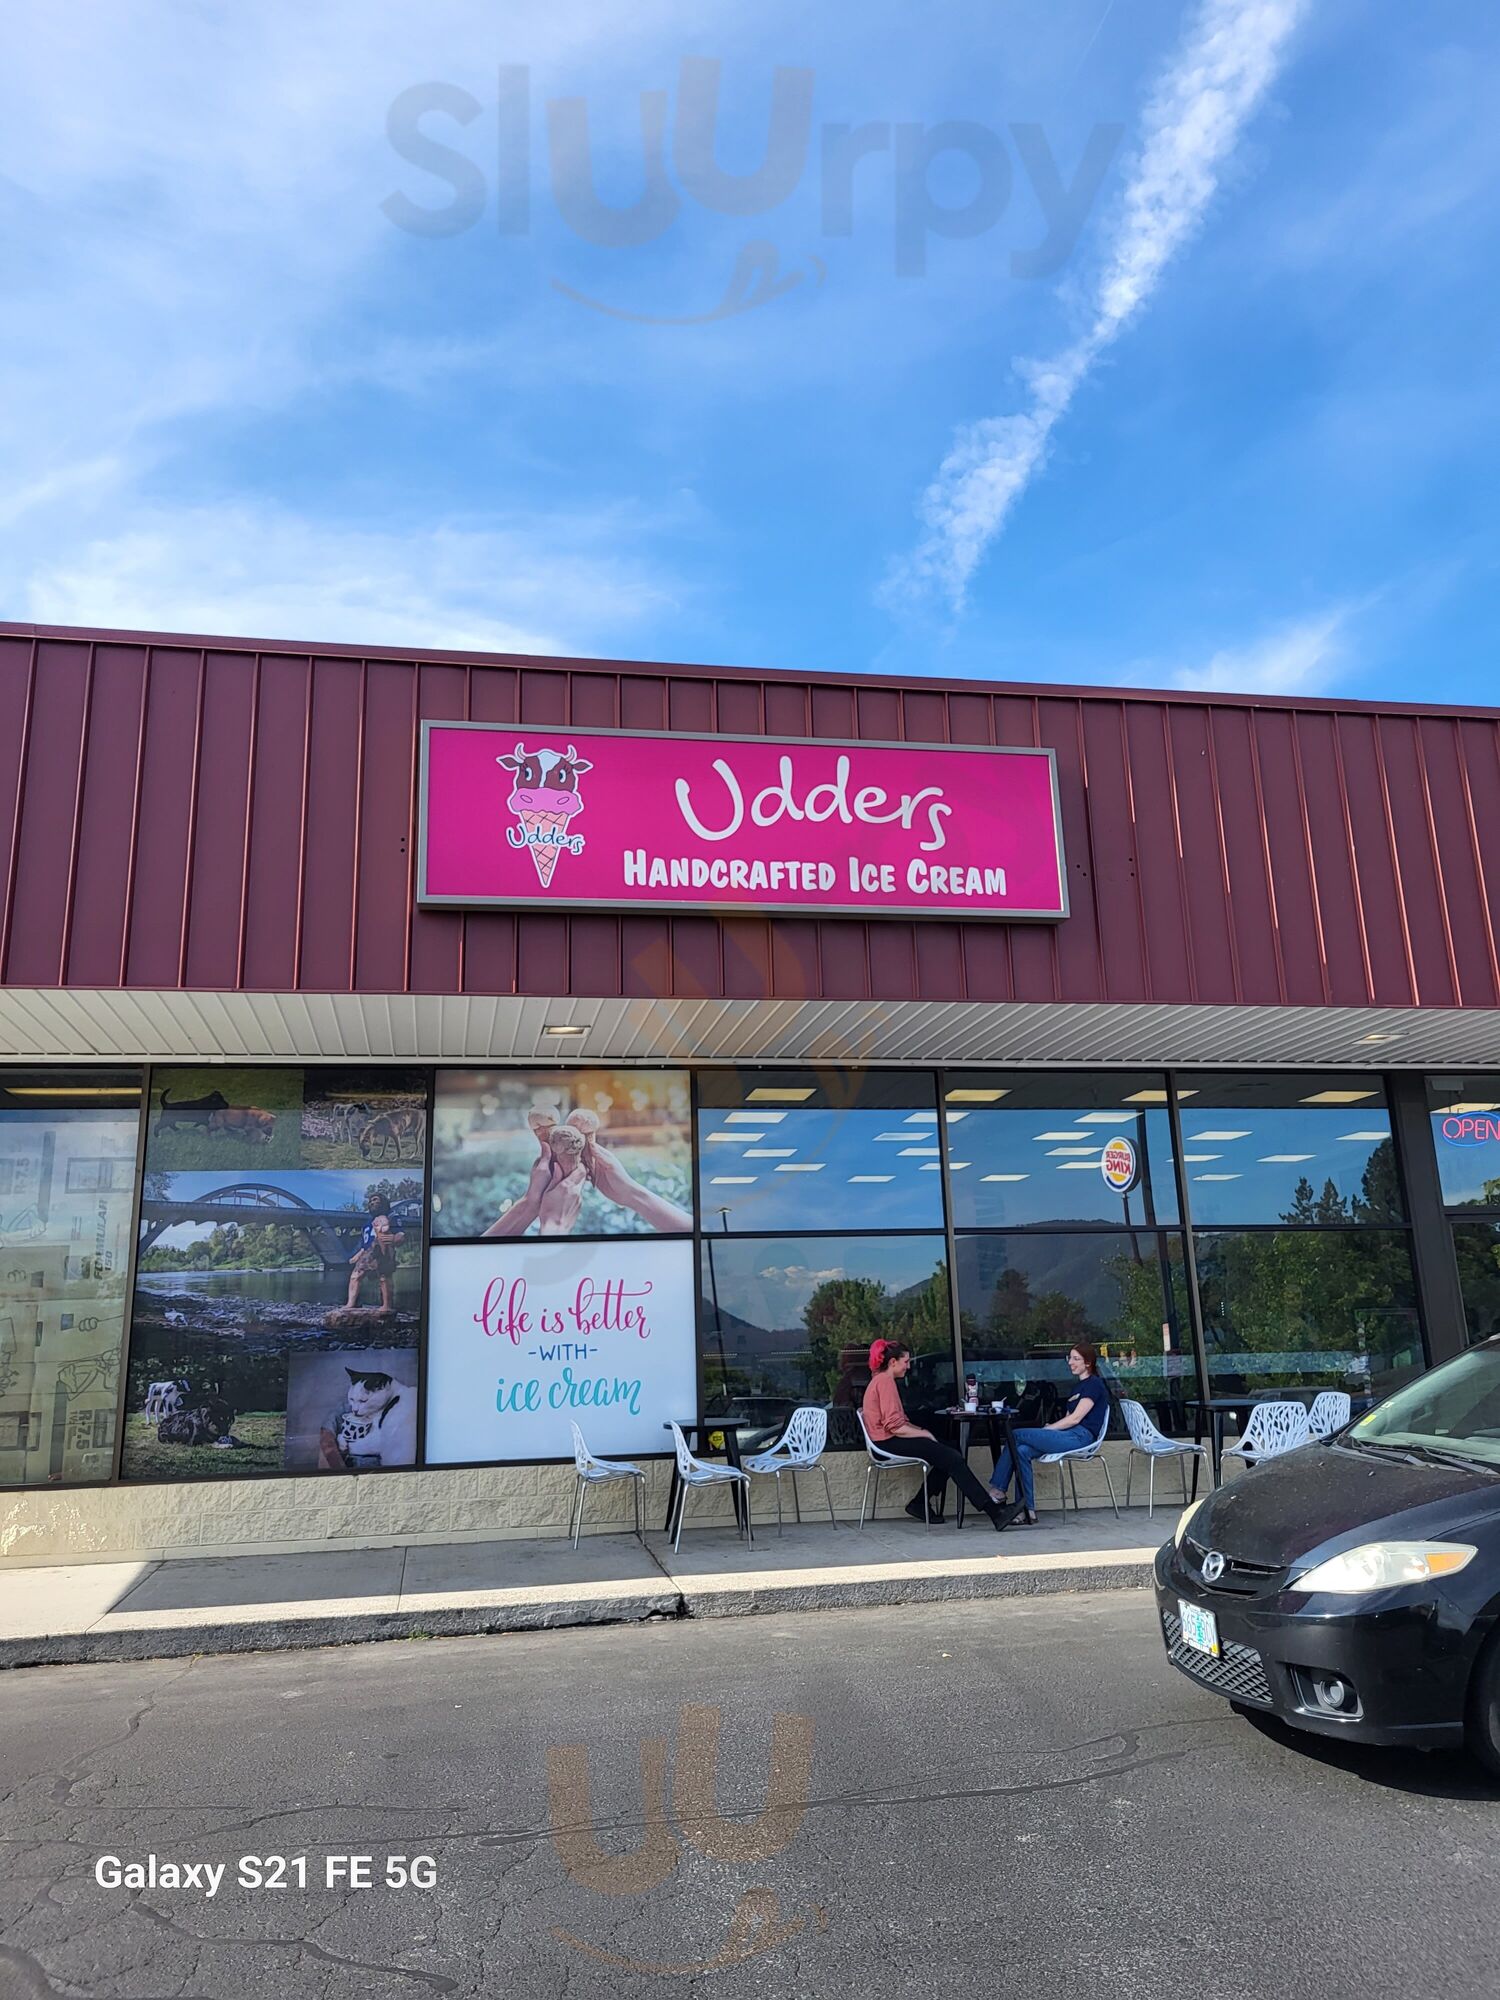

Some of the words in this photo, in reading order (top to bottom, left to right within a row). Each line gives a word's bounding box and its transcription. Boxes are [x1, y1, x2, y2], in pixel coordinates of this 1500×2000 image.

[675, 755, 953, 852] Udders
[507, 825, 584, 854] Udders
[623, 849, 836, 892] HANDCRAFTED
[848, 856, 896, 893] ICE
[906, 858, 1007, 896] CREAM
[1442, 1117, 1500, 1141] OPEN
[473, 1276, 533, 1346] life
[540, 1307, 565, 1334] is
[568, 1277, 653, 1339] better
[496, 1377, 542, 1413] ice
[548, 1366, 642, 1416] cream
